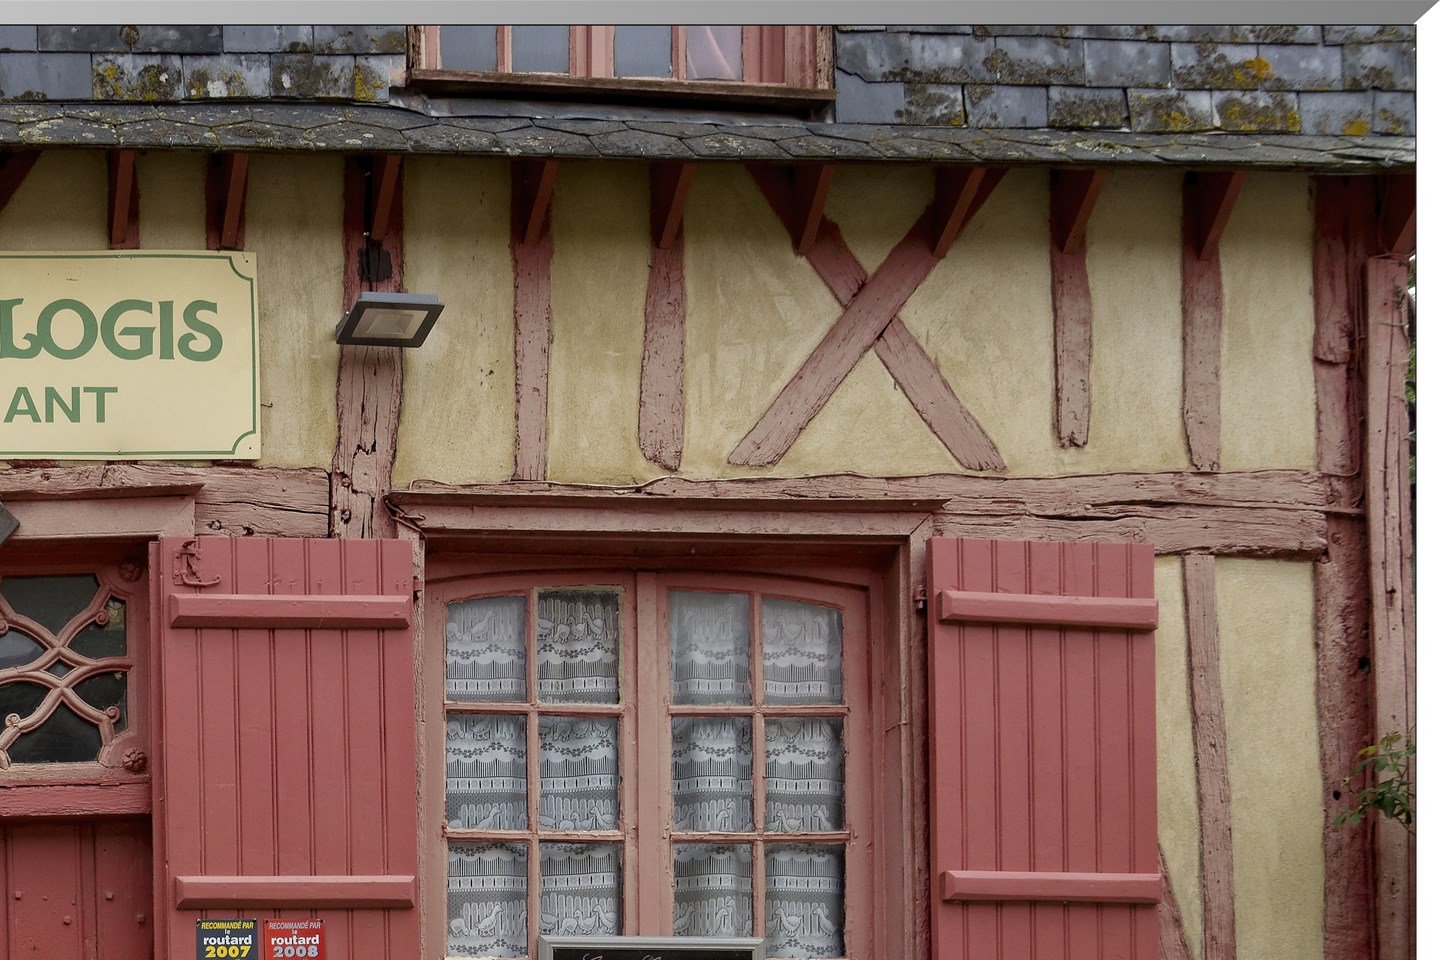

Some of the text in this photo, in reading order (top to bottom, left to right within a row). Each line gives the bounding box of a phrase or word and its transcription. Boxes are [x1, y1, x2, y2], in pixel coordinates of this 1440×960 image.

[201, 921, 254, 930] RECOMMANDÉ PAR
[269, 920, 321, 930] RECOMMANDÉ PAR
[203, 934, 253, 945] routard
[271, 934, 320, 945] routard
[205, 945, 252, 958] 2007
[273, 945, 319, 958] 2008
